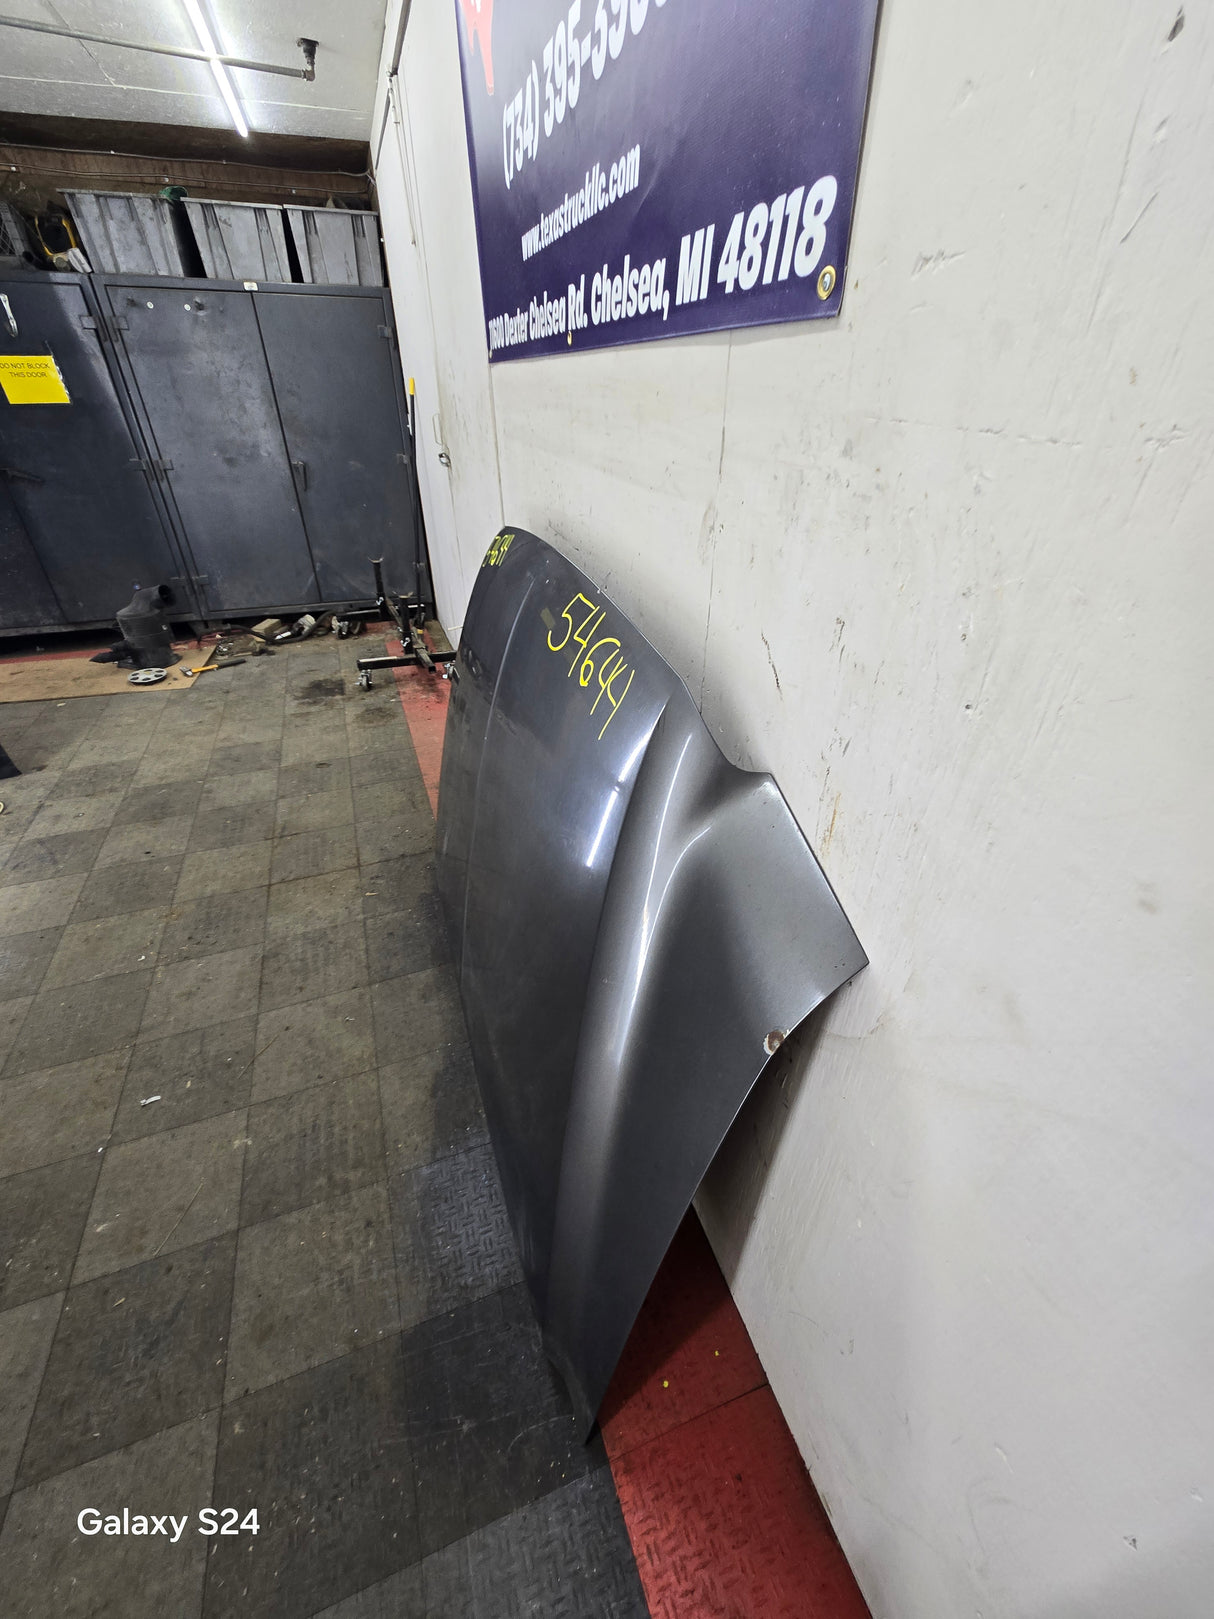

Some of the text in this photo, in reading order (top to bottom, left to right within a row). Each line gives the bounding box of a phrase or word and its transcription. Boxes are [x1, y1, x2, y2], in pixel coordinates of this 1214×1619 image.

[502, 0, 668, 190] (734) 395-39
[504, 307, 528, 347] Dexter
[529, 290, 566, 341] Chelsea
[567, 275, 588, 331] Rd.
[591, 254, 670, 326] Chelsea,
[676, 223, 715, 306] MI
[717, 175, 838, 295] 48118
[521, 143, 641, 262] www.texastruckllc.com
